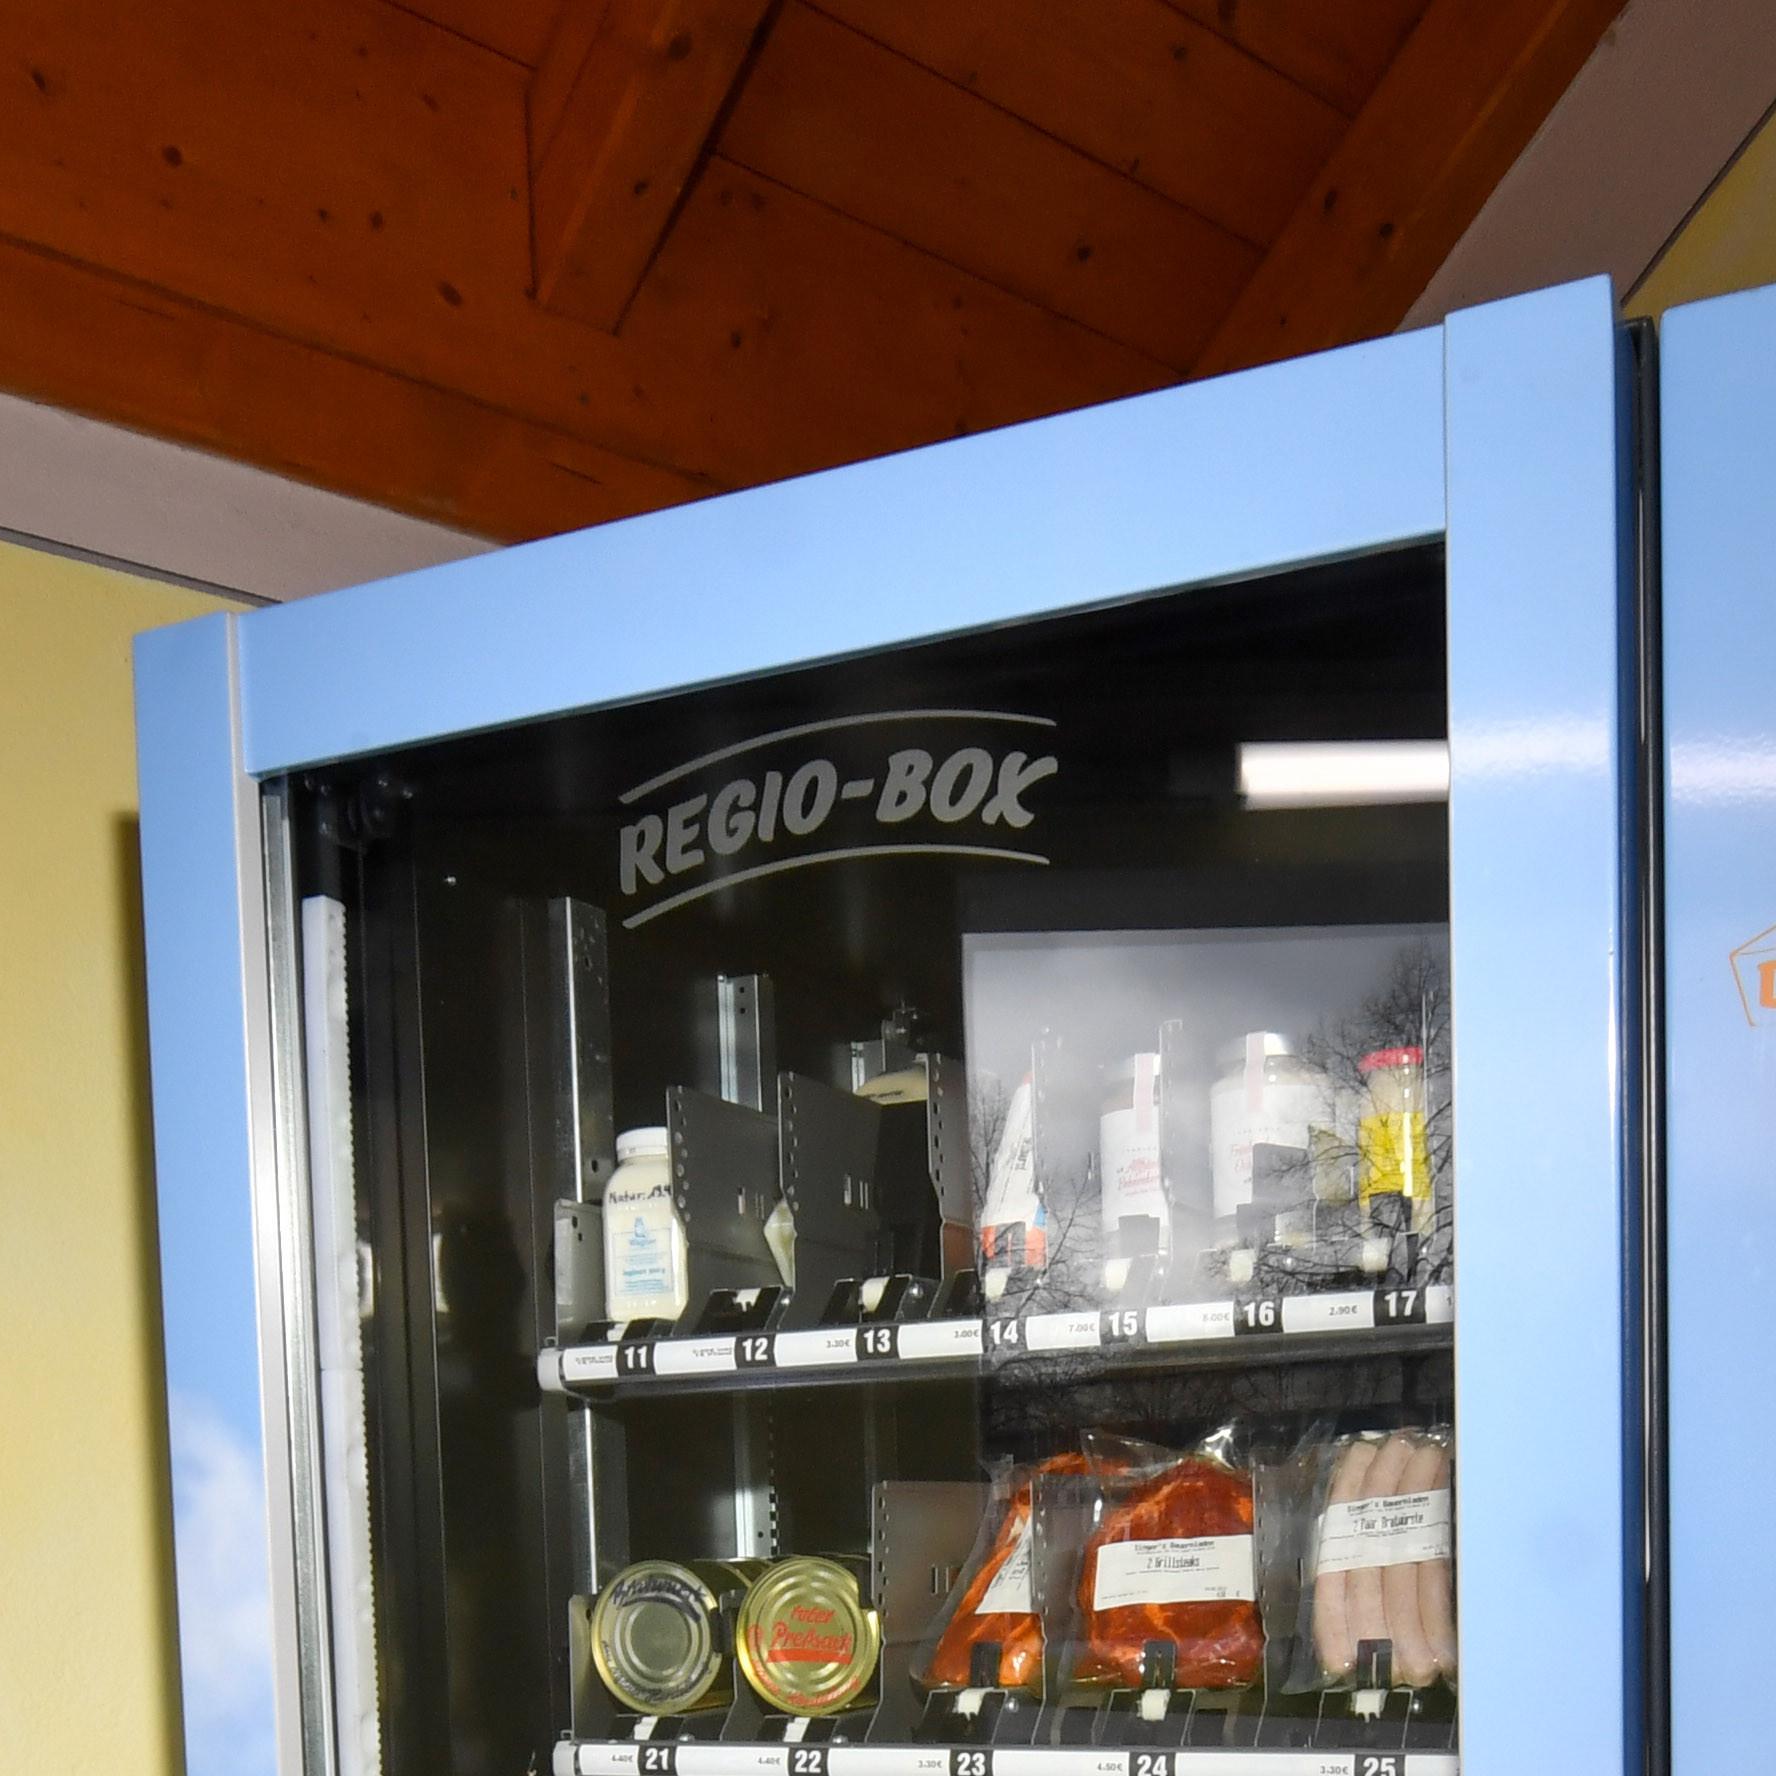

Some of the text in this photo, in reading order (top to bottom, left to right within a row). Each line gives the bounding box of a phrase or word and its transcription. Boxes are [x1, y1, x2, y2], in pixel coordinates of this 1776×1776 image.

[618, 746, 1059, 896] REGIO-BOX
[1243, 1301, 1275, 1327] 16
[1384, 1290, 1417, 1317] 17
[990, 1320, 1019, 1345] 14
[1108, 1312, 1139, 1337] 15
[741, 1337, 769, 1362] 12
[863, 1328, 892, 1354] 13
[625, 1345, 648, 1369] 11
[645, 1748, 669, 1771] 21
[794, 1750, 822, 1773] 22
